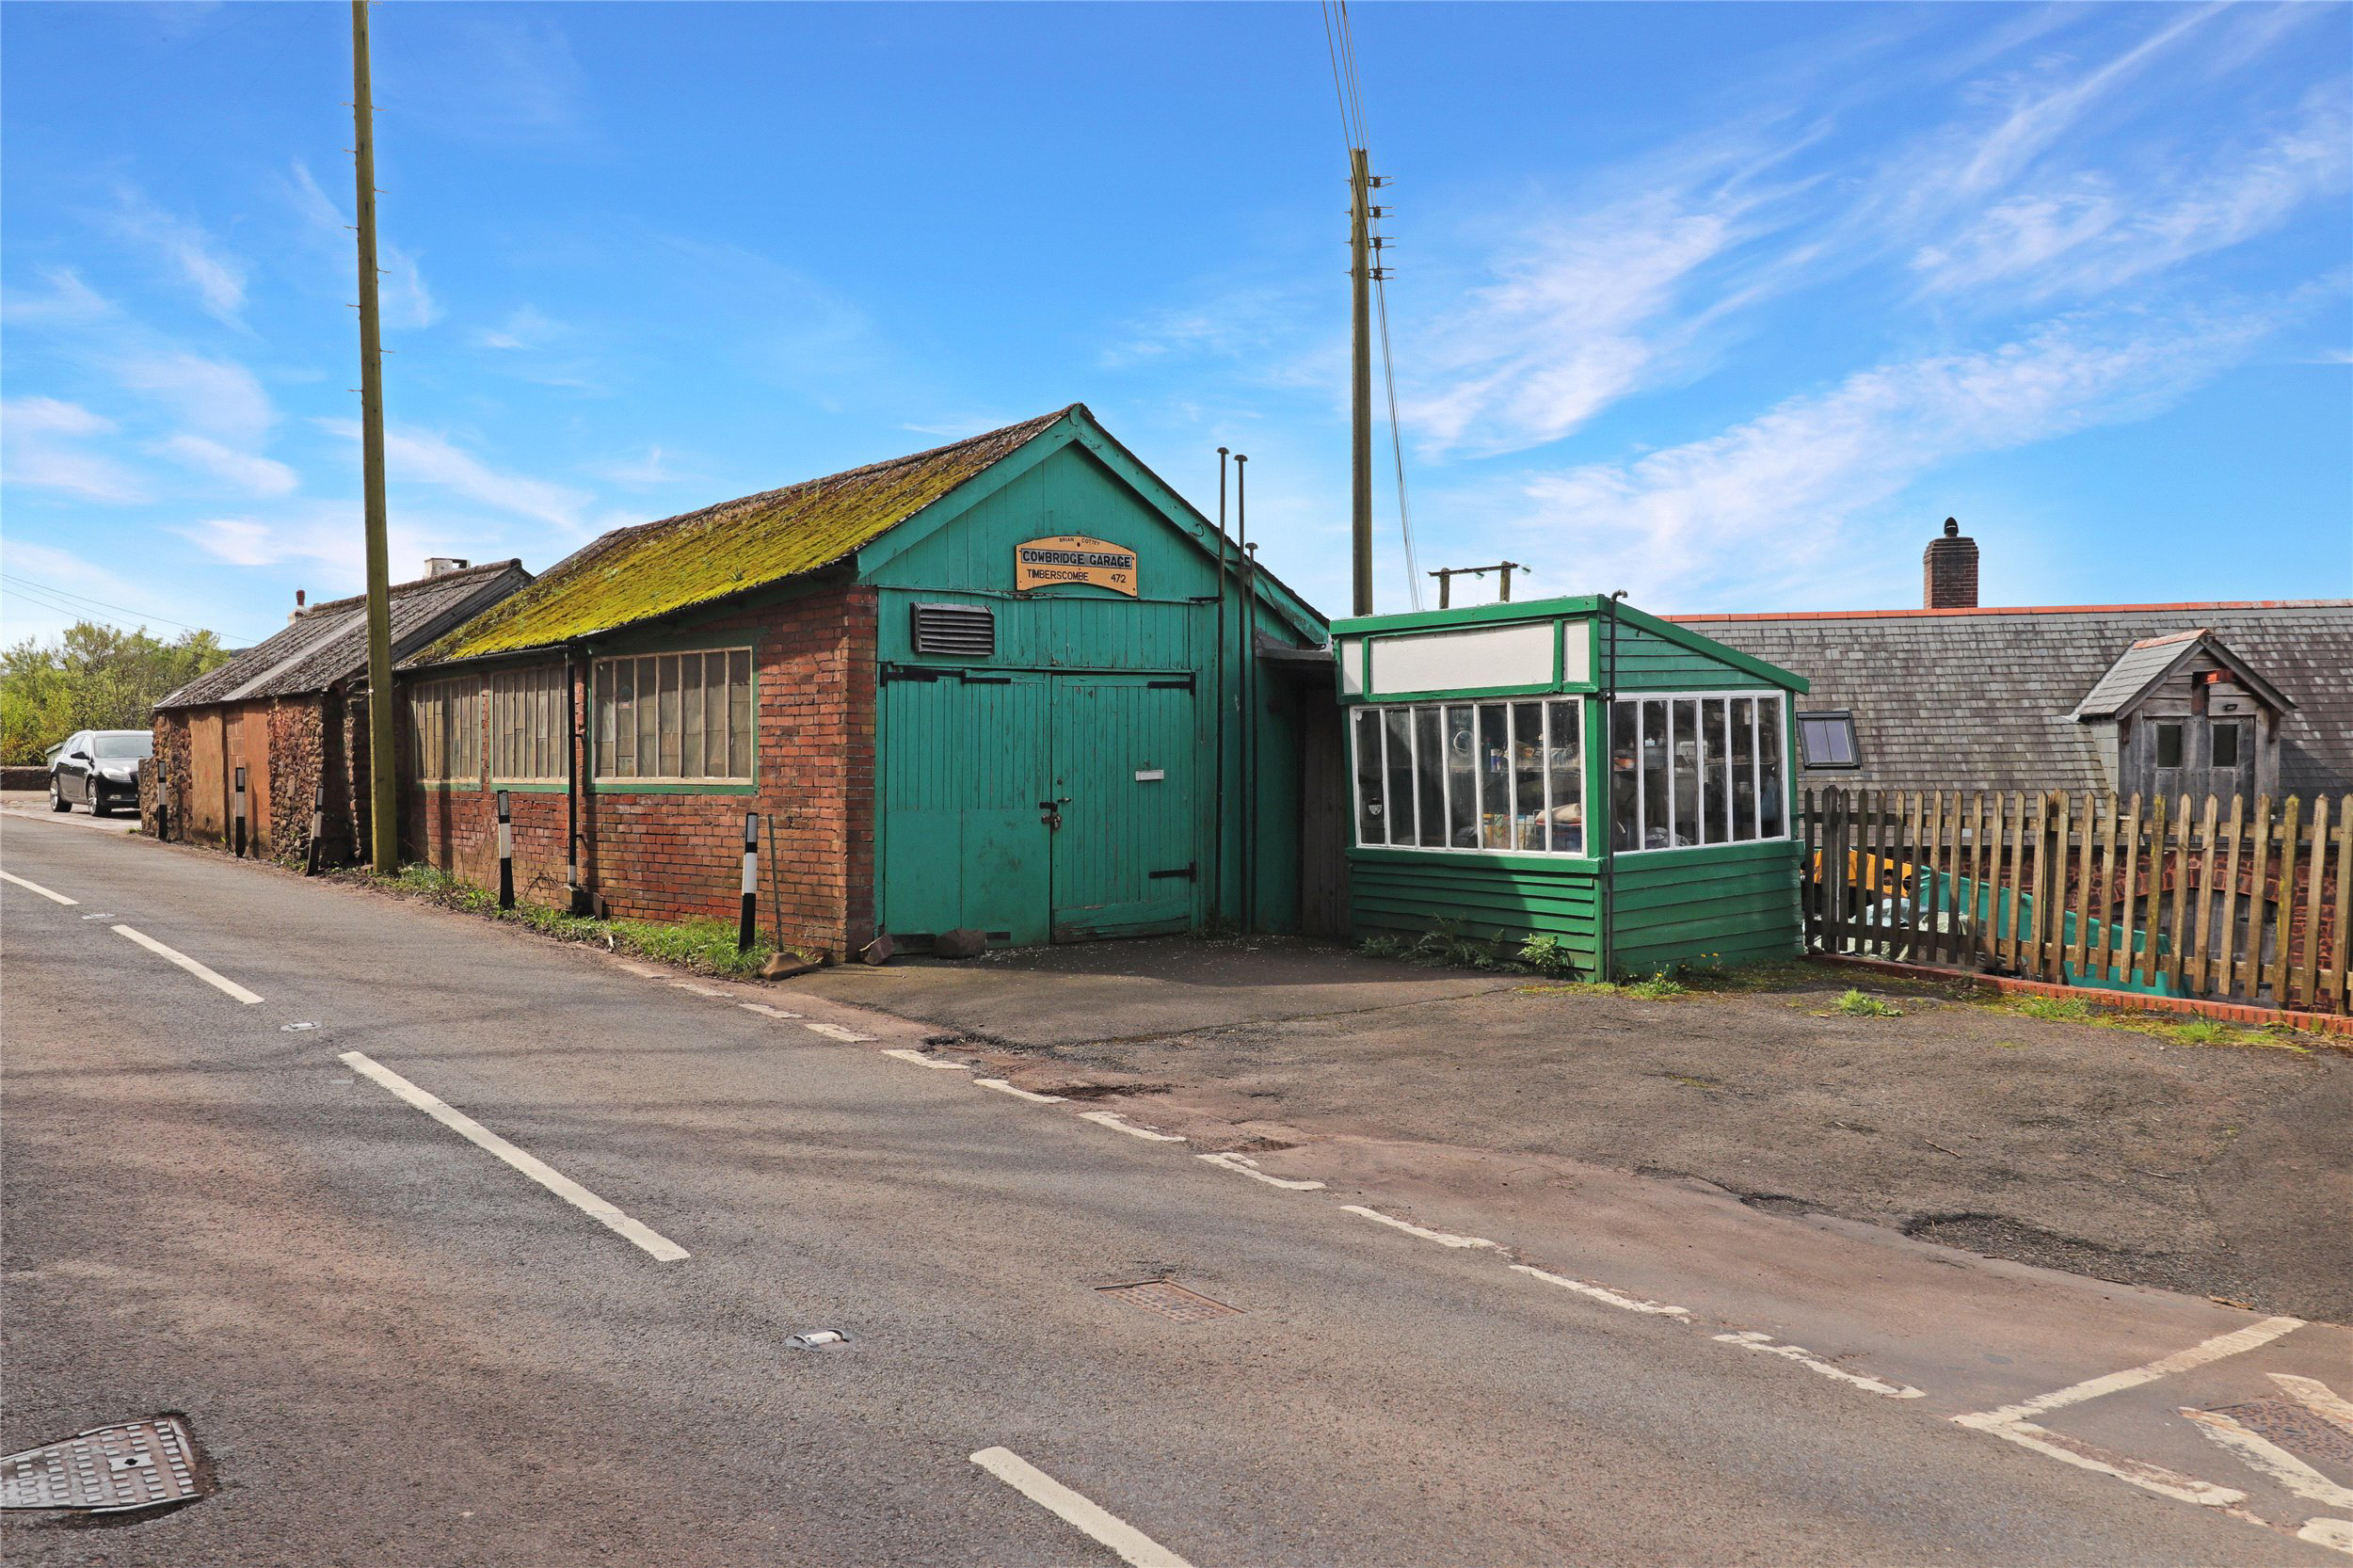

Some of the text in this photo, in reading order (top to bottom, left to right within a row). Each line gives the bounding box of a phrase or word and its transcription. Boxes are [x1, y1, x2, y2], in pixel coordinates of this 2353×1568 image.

[1022, 551, 1131, 568] COWBRIDGE GARAGE
[1027, 568, 1127, 584] TIMBERSCOMBE 472
